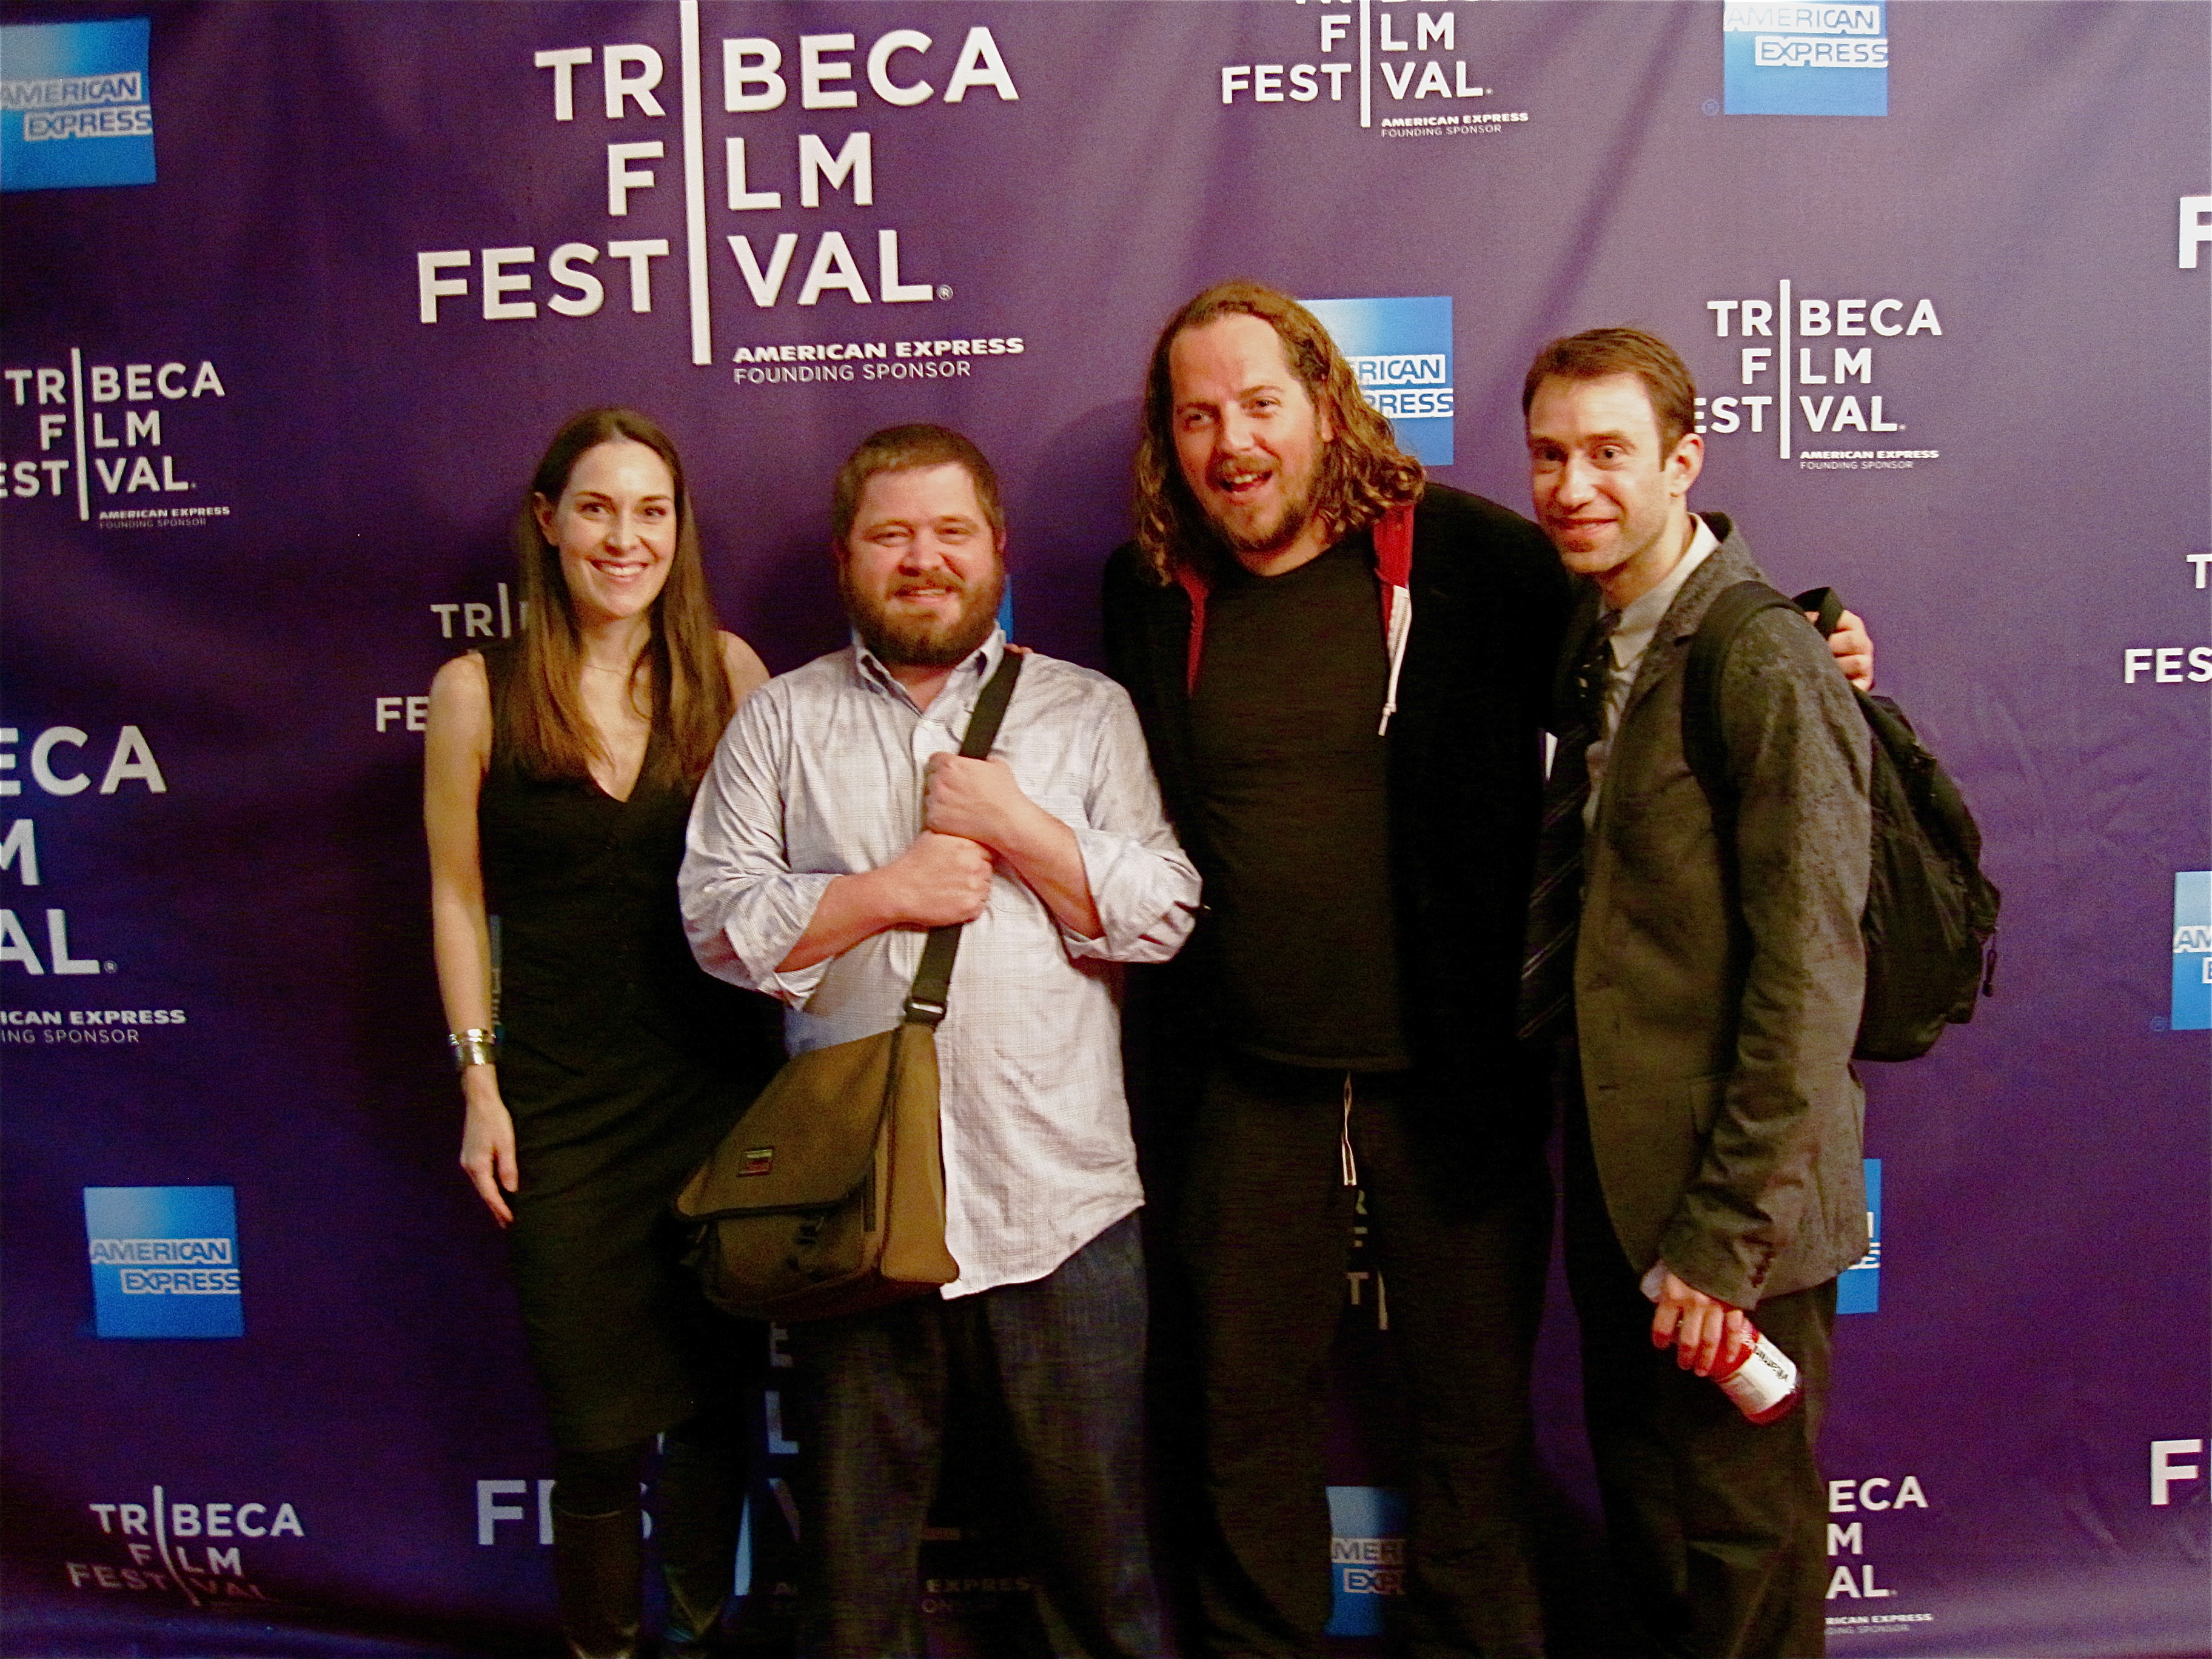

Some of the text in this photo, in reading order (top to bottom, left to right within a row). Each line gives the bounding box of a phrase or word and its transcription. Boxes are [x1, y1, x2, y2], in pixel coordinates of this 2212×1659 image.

[1726, 7, 1874, 29] AMERICAN
[1760, 41, 1888, 62] EXPRESS
[30, 110, 152, 136] EXPRESS
[1381, 112, 1529, 127] AMERICAN EXPRESS
[1381, 124, 1502, 138] FOUNDING SPONSOR
[732, 337, 1024, 363] AMERICAN EXPRESS
[734, 360, 971, 384] FOUNDING SPONSOR
[1352, 359, 1440, 381] RICAN
[1362, 392, 1453, 414] PRESS
[1799, 450, 1939, 459] AMERICAN EXPRESS
[1800, 461, 1914, 469] FOUNDING SPONSOR
[99, 506, 230, 519] AMERICAN EXPRESS
[70, 1009, 187, 1025] EXPRESS
[44, 1029, 139, 1044] SPONSOR
[91, 1242, 227, 1261] AMERICAN
[125, 1272, 241, 1290] EXPRESS
